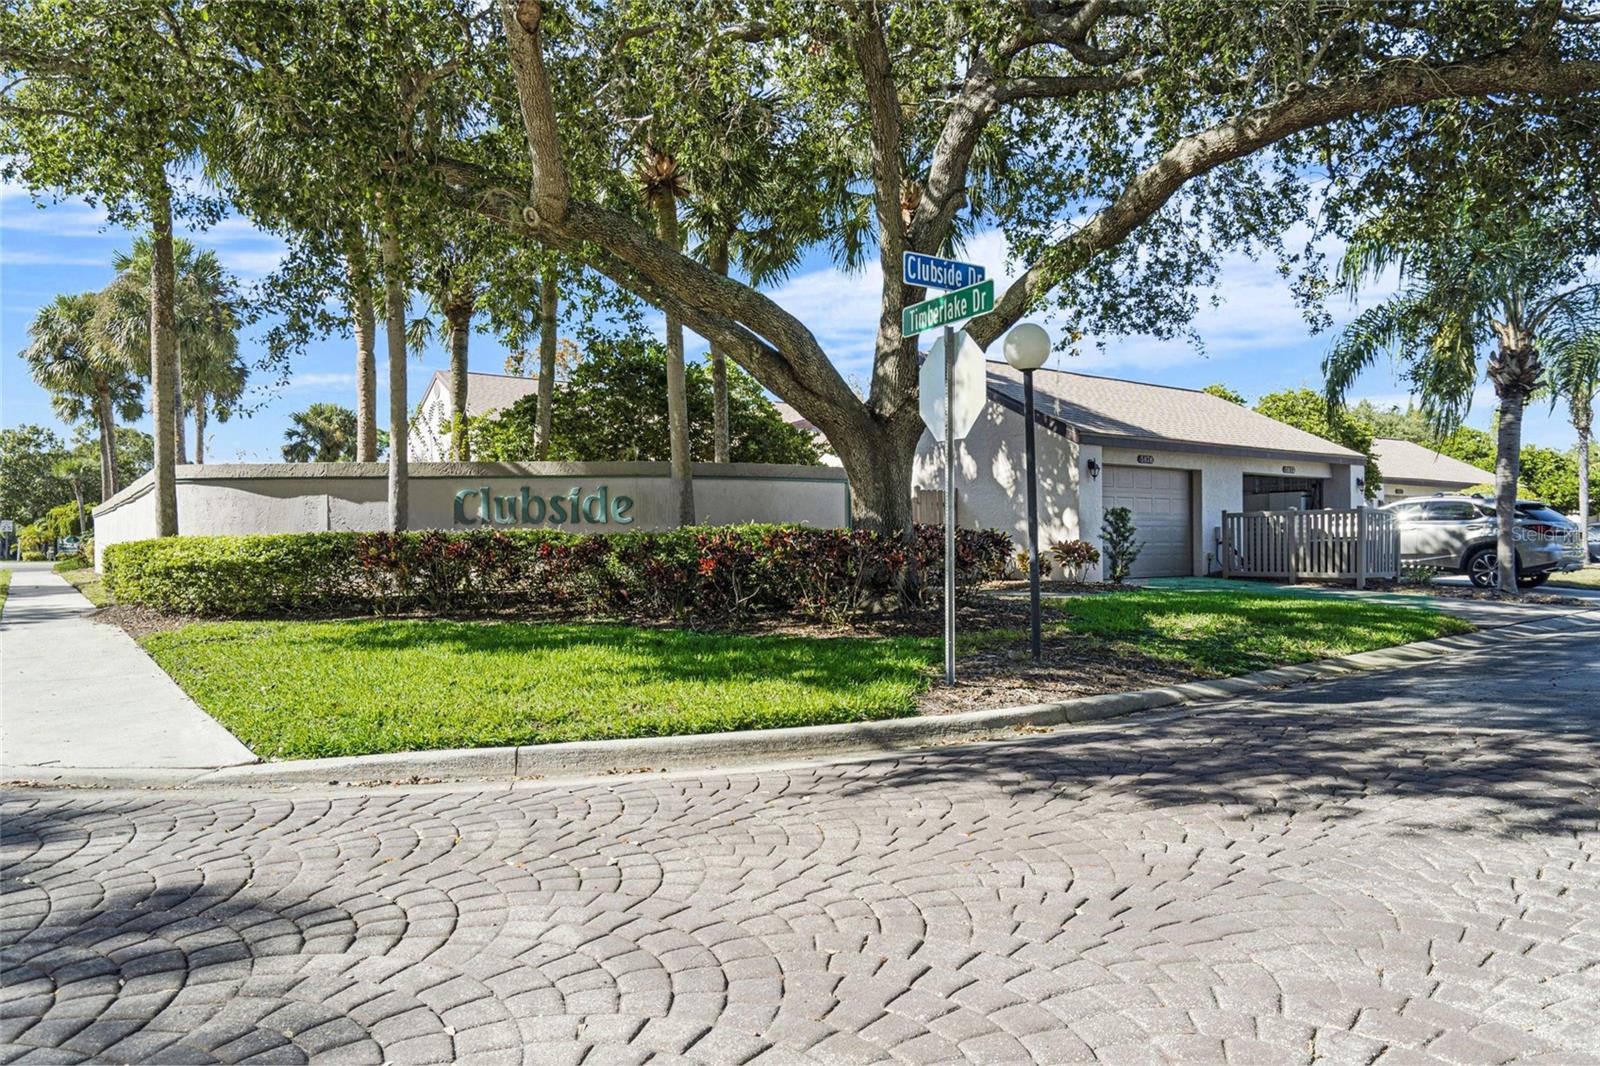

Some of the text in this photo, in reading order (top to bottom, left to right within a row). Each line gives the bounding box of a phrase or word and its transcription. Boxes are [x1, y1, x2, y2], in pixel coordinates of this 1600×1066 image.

[907, 255, 983, 287] Clubside Dr
[909, 288, 987, 332] Timberlake Dr
[453, 486, 635, 525] Clubside
